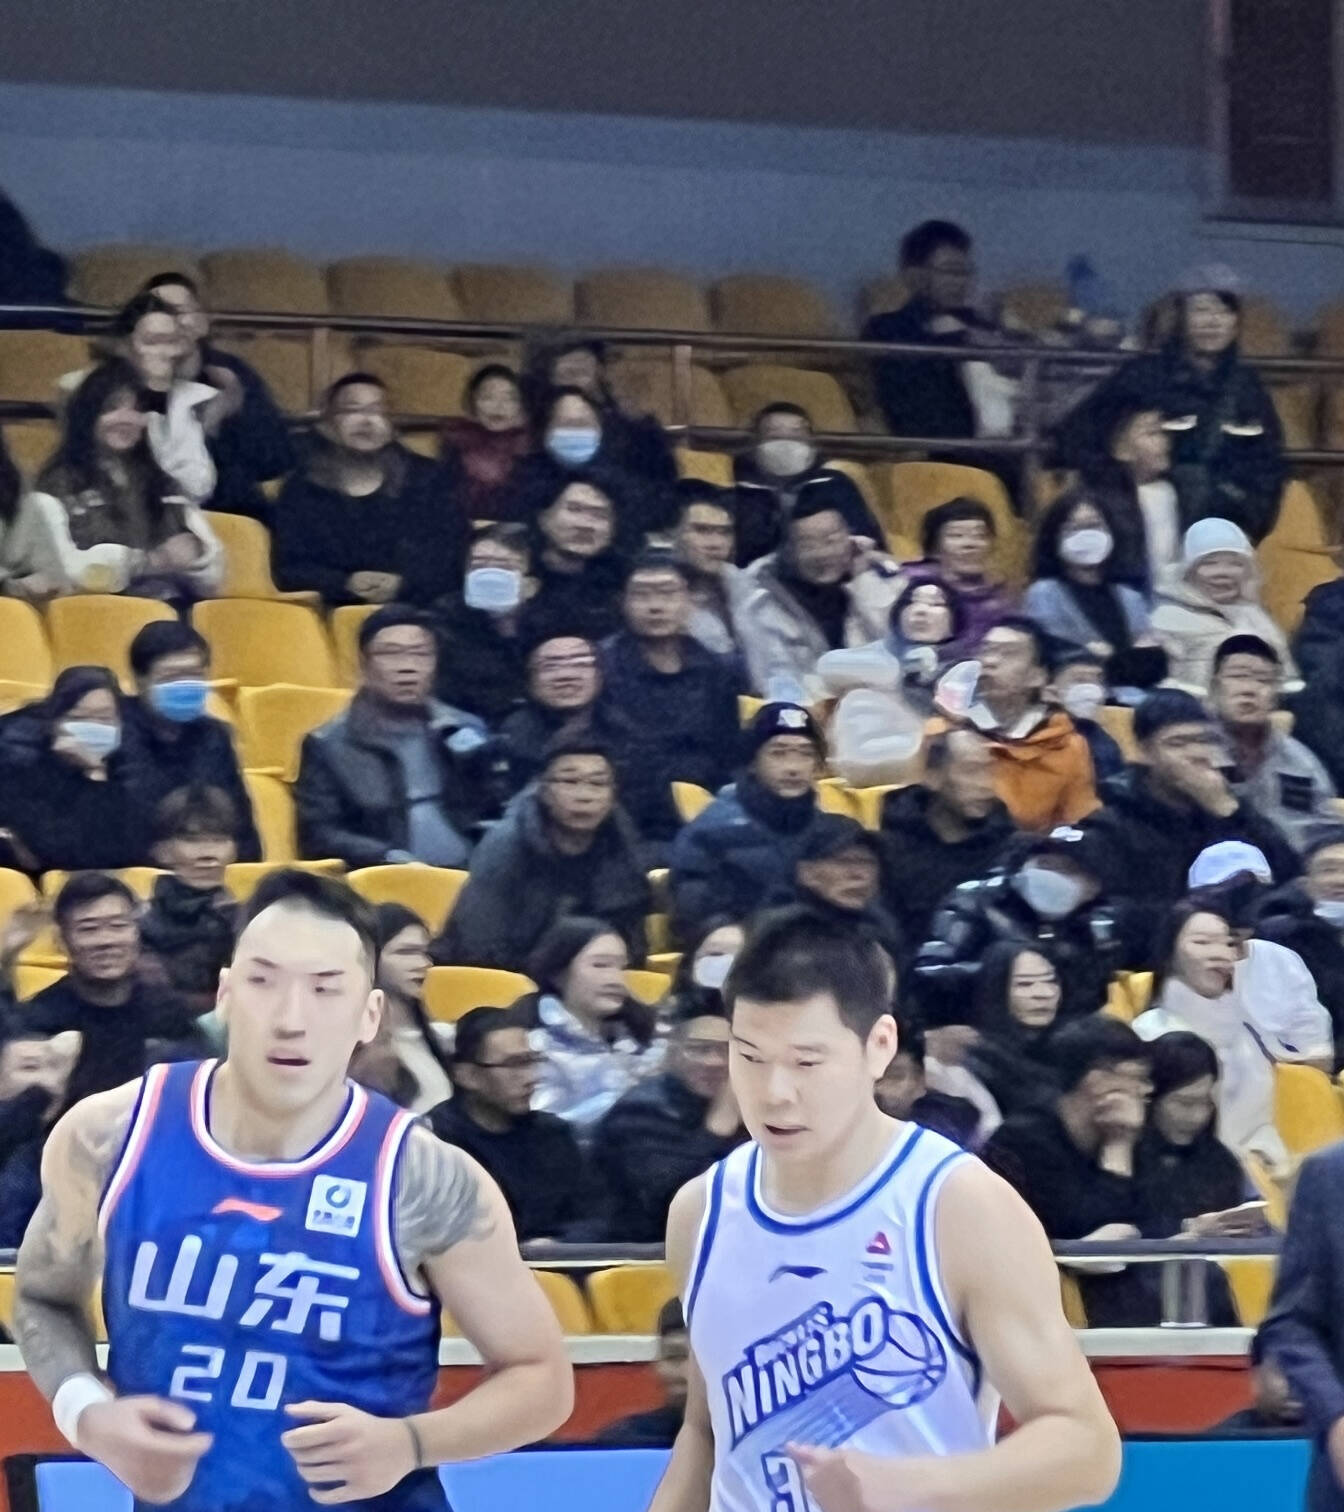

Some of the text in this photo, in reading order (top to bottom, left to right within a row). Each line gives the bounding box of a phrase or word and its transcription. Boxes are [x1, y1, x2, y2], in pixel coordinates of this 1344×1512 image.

[128, 1234, 360, 1341] 山东
[170, 1345, 287, 1410] 20
[724, 1298, 887, 1442] NINGBO
